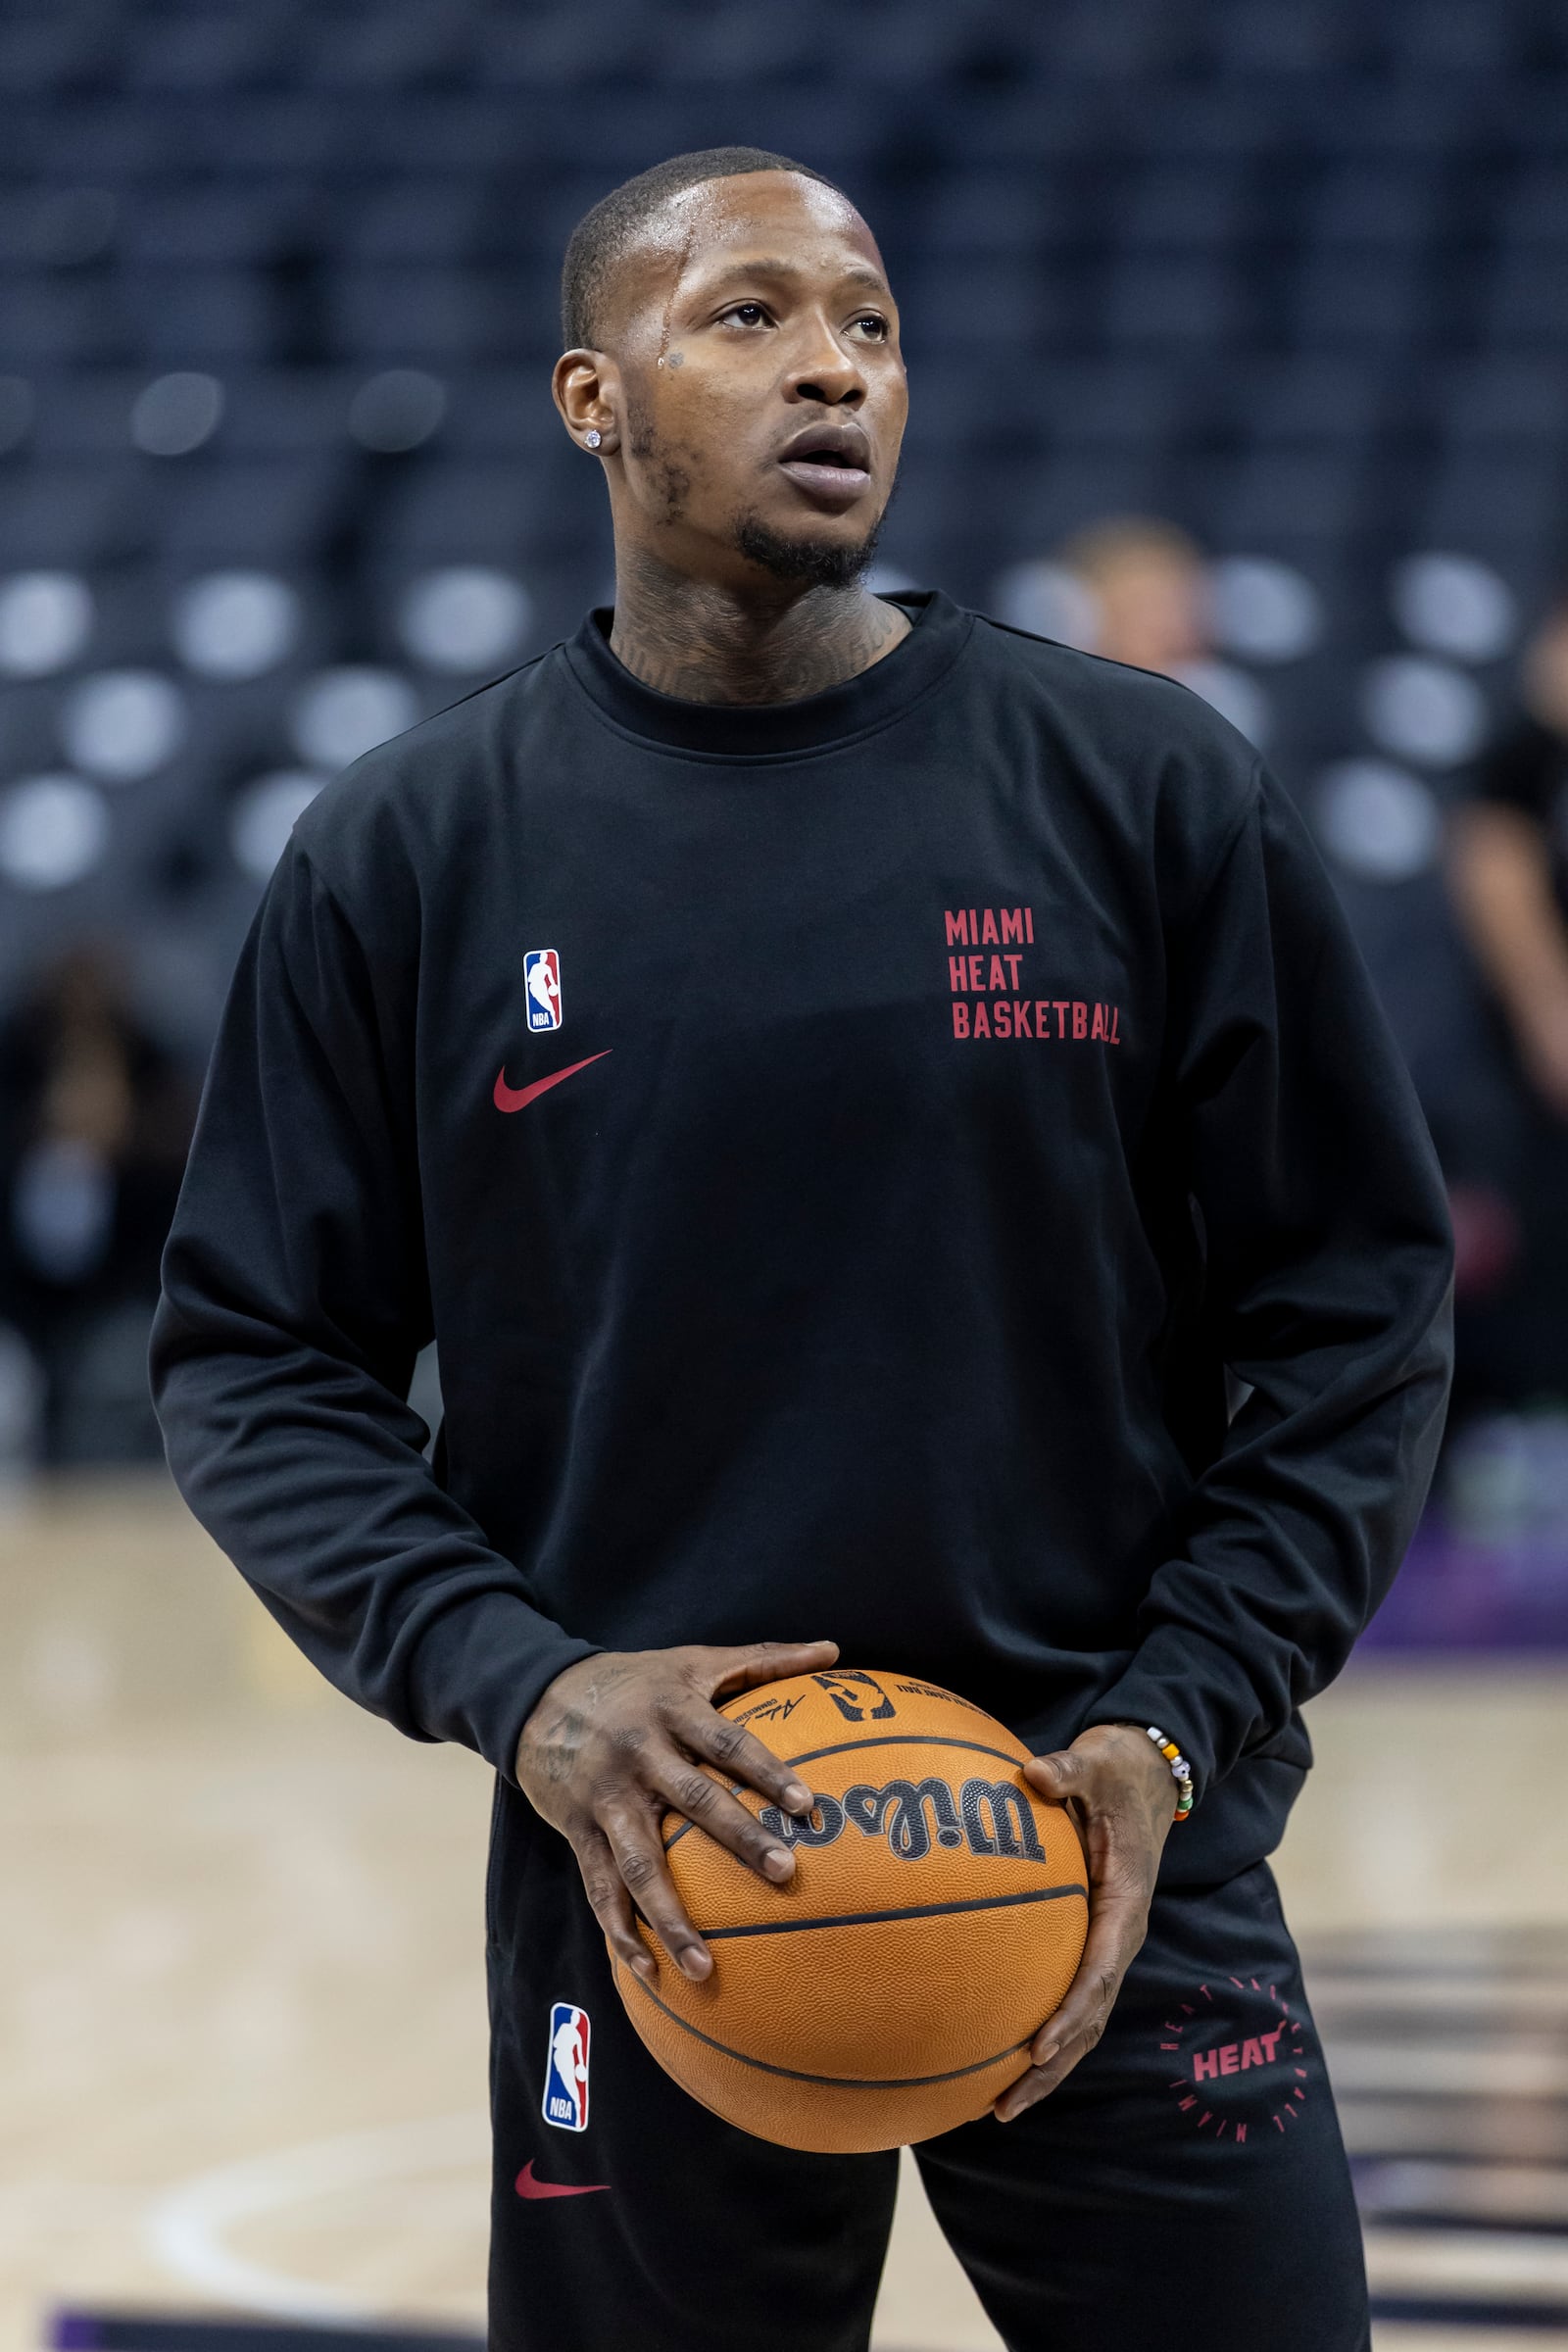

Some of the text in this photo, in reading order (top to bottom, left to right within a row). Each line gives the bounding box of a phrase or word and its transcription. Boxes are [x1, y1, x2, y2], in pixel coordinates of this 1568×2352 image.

[945, 907, 1034, 946] MIAMI
[949, 955, 1023, 992] HEAT
[532, 1011, 550, 1027] NBA
[953, 1001, 1120, 1045] BASKETBALL
[1193, 2020, 1287, 2082] HEAT
[550, 2096, 572, 2121] NBA
